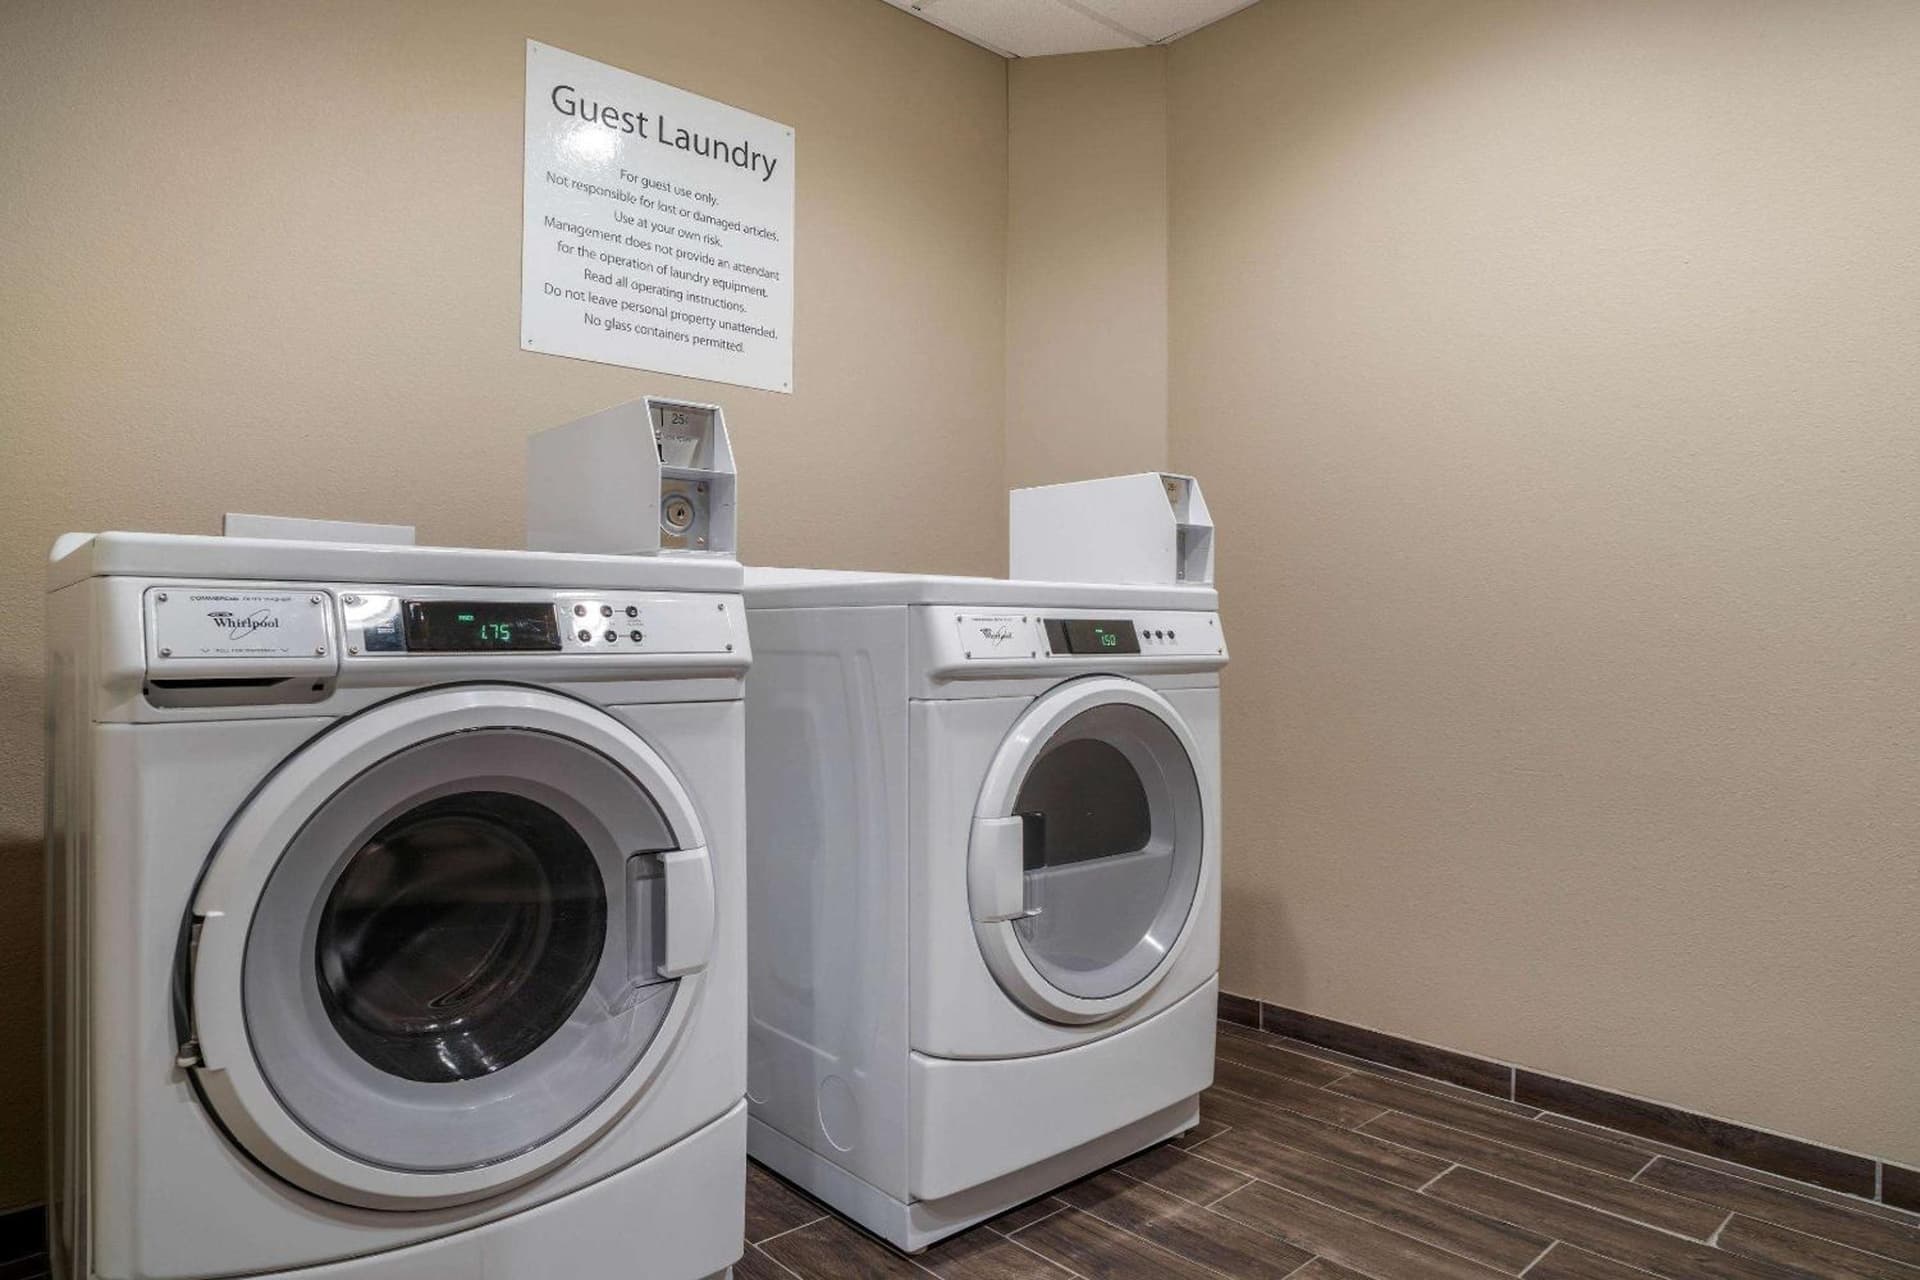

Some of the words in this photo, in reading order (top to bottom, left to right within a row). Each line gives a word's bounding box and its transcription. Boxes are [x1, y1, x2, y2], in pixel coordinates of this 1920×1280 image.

[552, 85, 648, 138] Guest
[659, 115, 777, 182] Laundry
[546, 171, 569, 187] Not
[571, 178, 637, 204] responsible
[640, 194, 655, 209] for
[658, 199, 677, 215] lost
[679, 208, 692, 217] or
[694, 208, 741, 232] damaged
[743, 224, 778, 242] articles.
[620, 169, 639, 184] For
[641, 176, 671, 193] guest
[674, 185, 692, 198] use
[695, 189, 719, 206] only.
[545, 216, 622, 244] Management
[625, 236, 651, 250] does
[655, 243, 672, 256] not
[676, 247, 715, 266] provide
[717, 259, 730, 269] an
[733, 262, 780, 281] attendant
[614, 210, 634, 226] Use
[637, 218, 648, 229] at
[651, 222, 675, 235] your
[678, 229, 700, 240] own
[703, 233, 722, 247] risk.
[558, 241, 574, 254] for
[578, 245, 597, 259] the
[600, 252, 653, 272] operation
[656, 264, 667, 276] of
[670, 267, 709, 286] laundry
[712, 277, 768, 297] equipment.
[584, 269, 612, 285] Read
[615, 275, 628, 288] all
[631, 280, 683, 300] operating
[686, 291, 747, 313] instructions.
[544, 282, 562, 297] Do
[565, 288, 585, 301] not
[589, 292, 618, 308] leave
[621, 300, 667, 317] personal
[671, 310, 716, 329] property
[719, 319, 778, 339] unattended.
[584, 312, 601, 326] No
[604, 318, 632, 333] glass
[634, 322, 689, 343] containers
[692, 335, 744, 352] permitted.
[213, 617, 279, 630] Whirlpool
